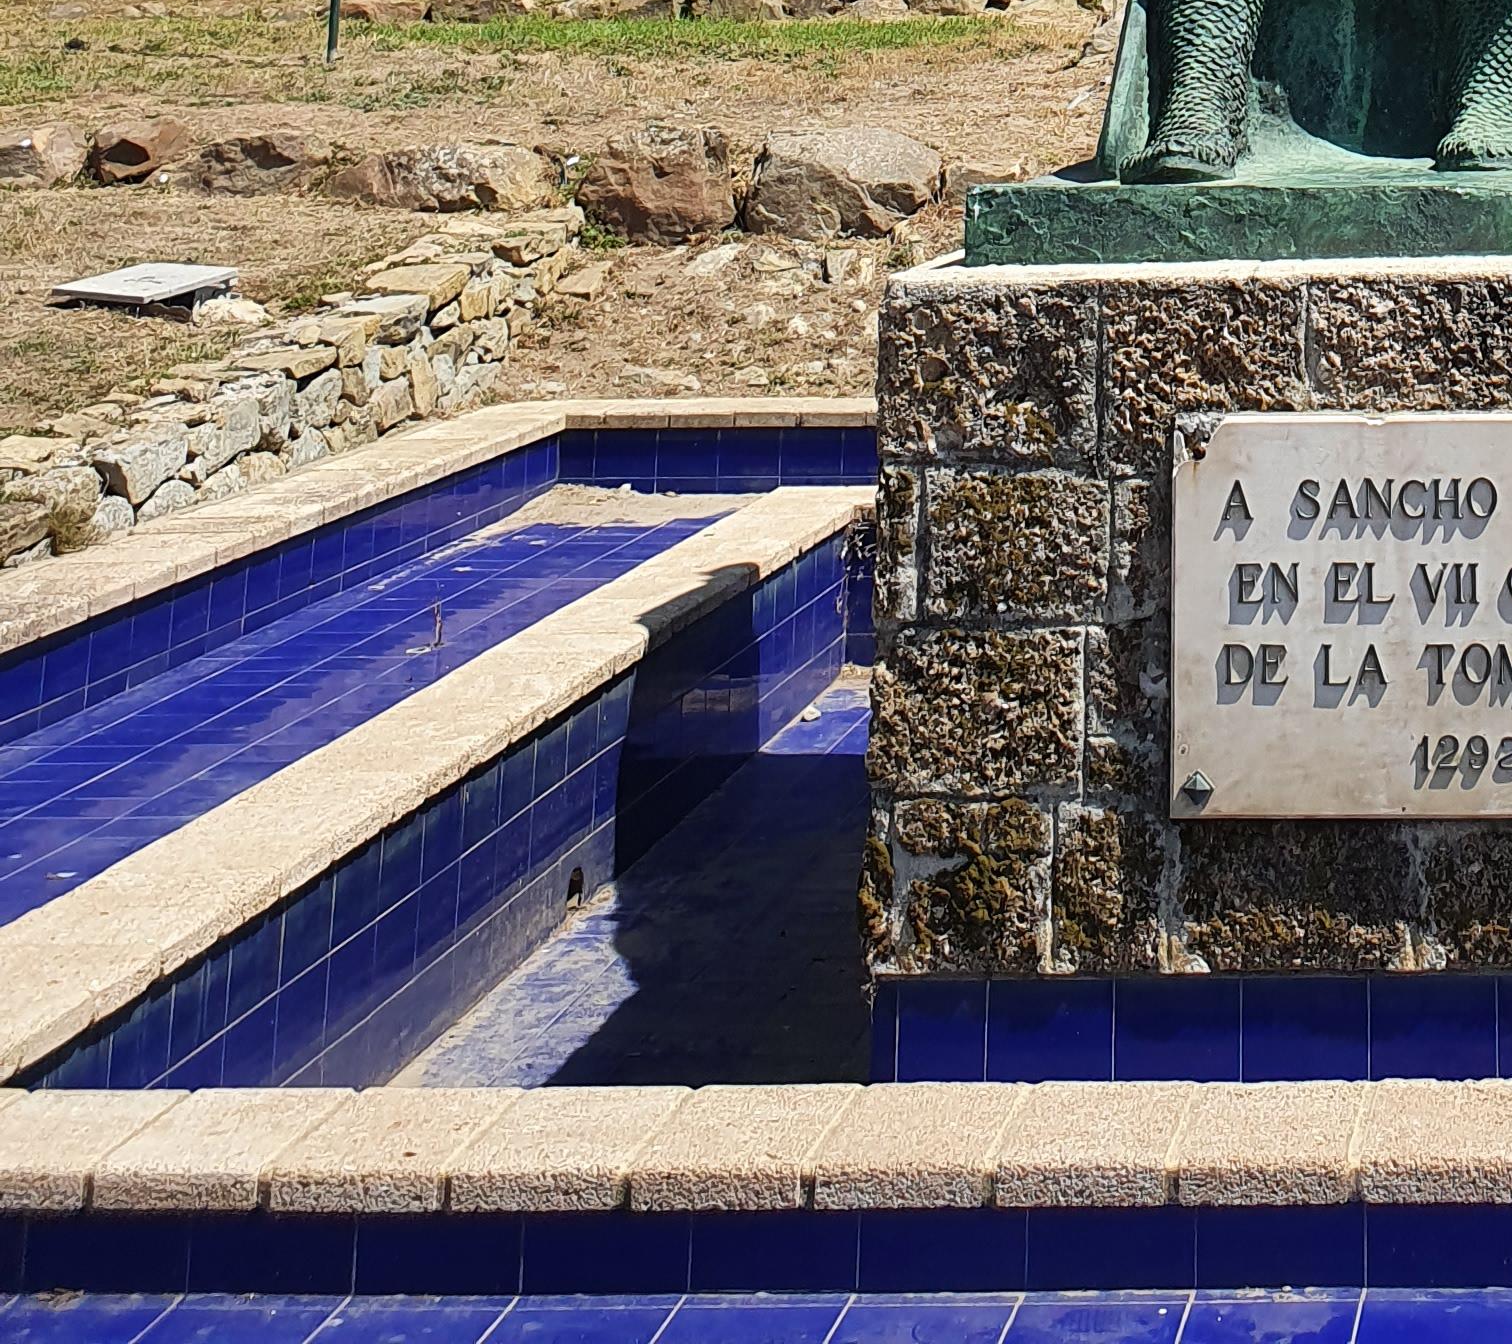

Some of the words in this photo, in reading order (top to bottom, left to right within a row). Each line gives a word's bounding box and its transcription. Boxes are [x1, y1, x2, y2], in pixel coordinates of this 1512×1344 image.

[1221, 478, 1254, 520] A
[1296, 477, 1498, 520] SANCHO
[1235, 562, 1299, 604] EN
[1332, 562, 1395, 604] EL
[1418, 562, 1479, 604] VII
[1223, 644, 1288, 685] DE
[1320, 643, 1389, 686] LA
